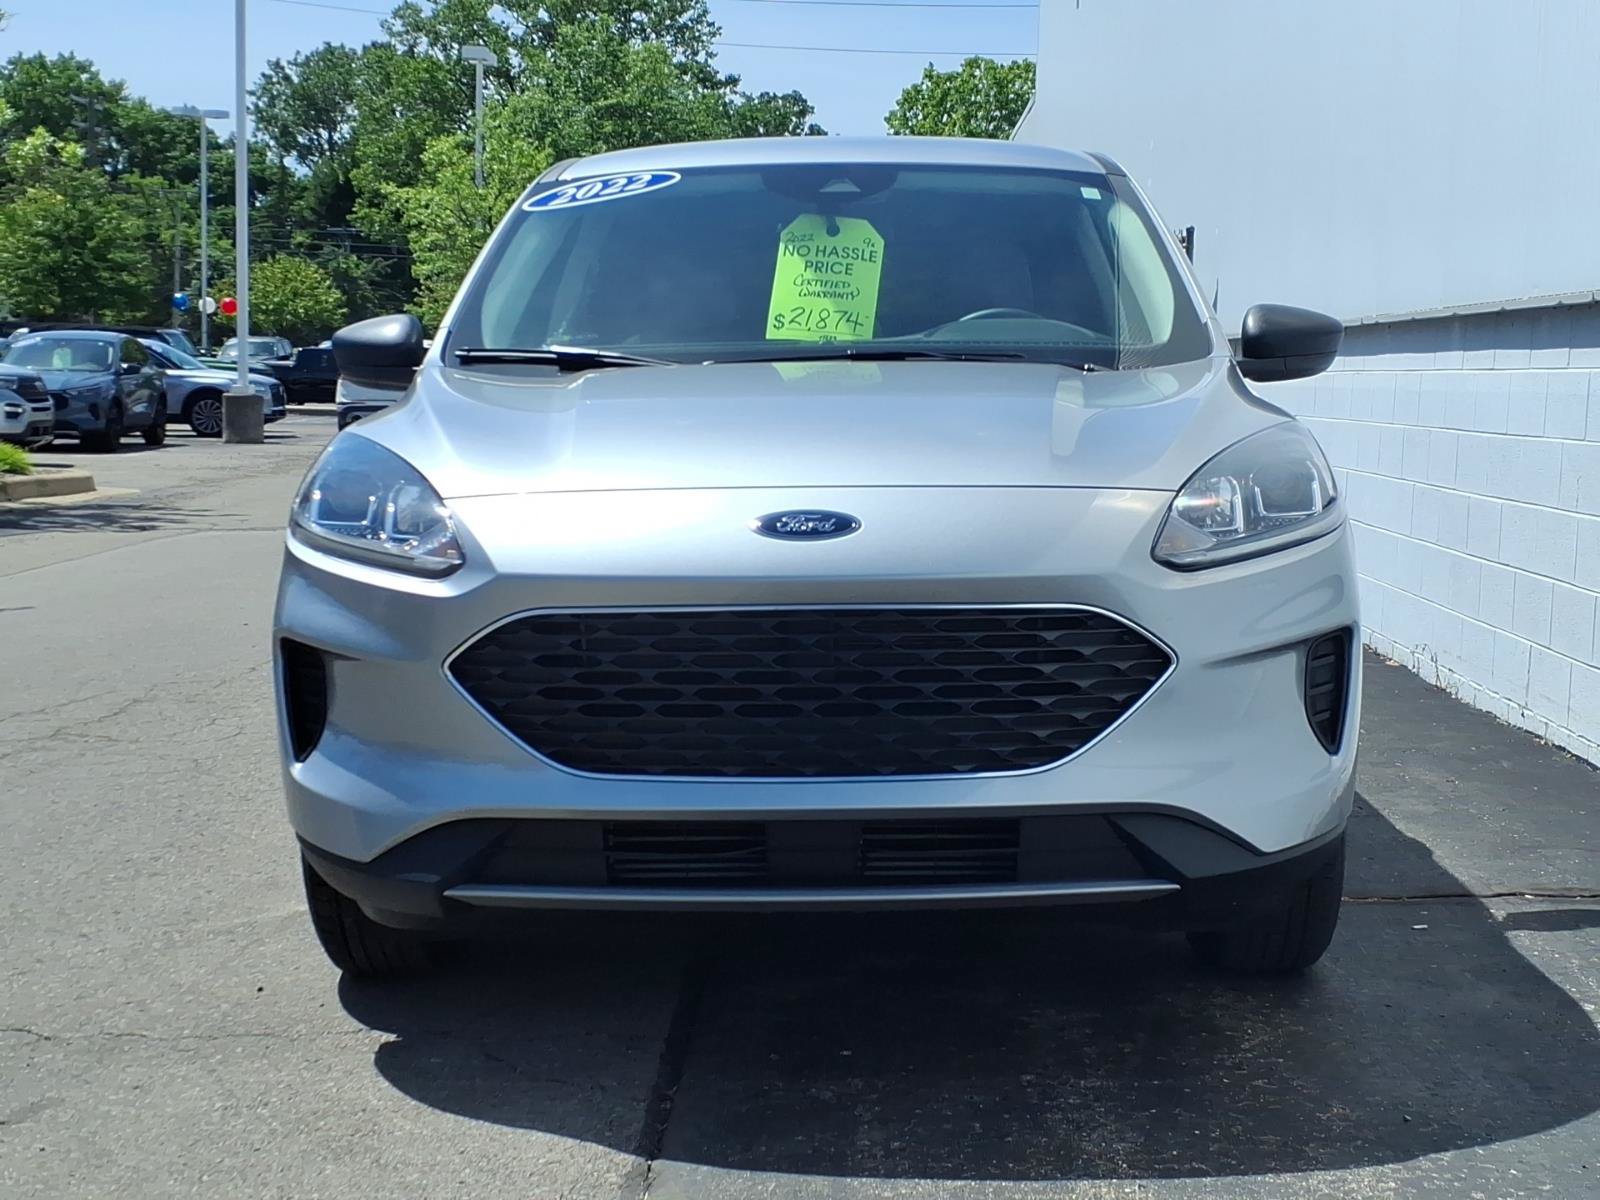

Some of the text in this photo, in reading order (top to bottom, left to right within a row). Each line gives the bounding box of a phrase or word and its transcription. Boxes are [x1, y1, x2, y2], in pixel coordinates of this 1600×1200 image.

[548, 174, 652, 206] 2022
[783, 244, 878, 264] NO HASSLE
[804, 260, 854, 276] PRICE
[776, 514, 836, 532] Ford
